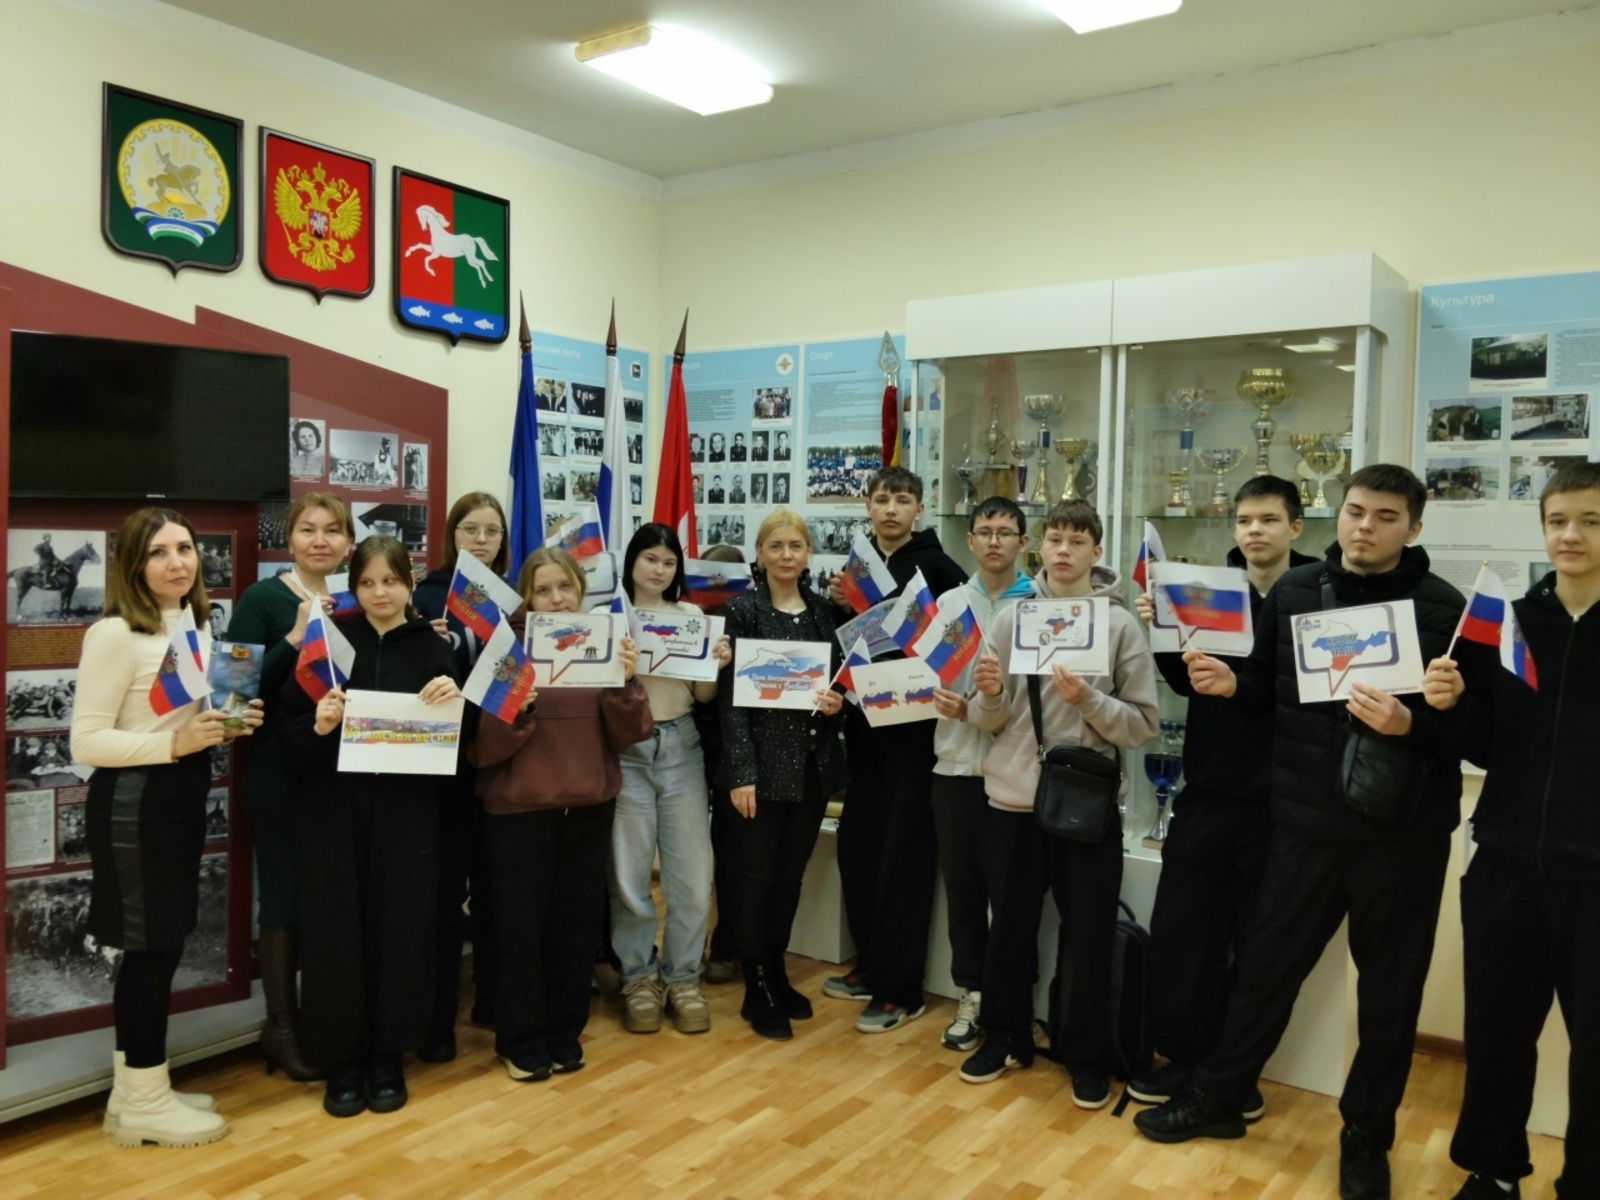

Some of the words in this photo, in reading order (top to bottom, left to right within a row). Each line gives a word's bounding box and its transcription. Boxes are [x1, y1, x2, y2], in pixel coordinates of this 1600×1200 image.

[1430, 293, 1495, 310] Культура
[809, 351, 834, 362] Спорт
[1327, 633, 1358, 646] КРЫМ
[343, 726, 412, 743] Крымская
